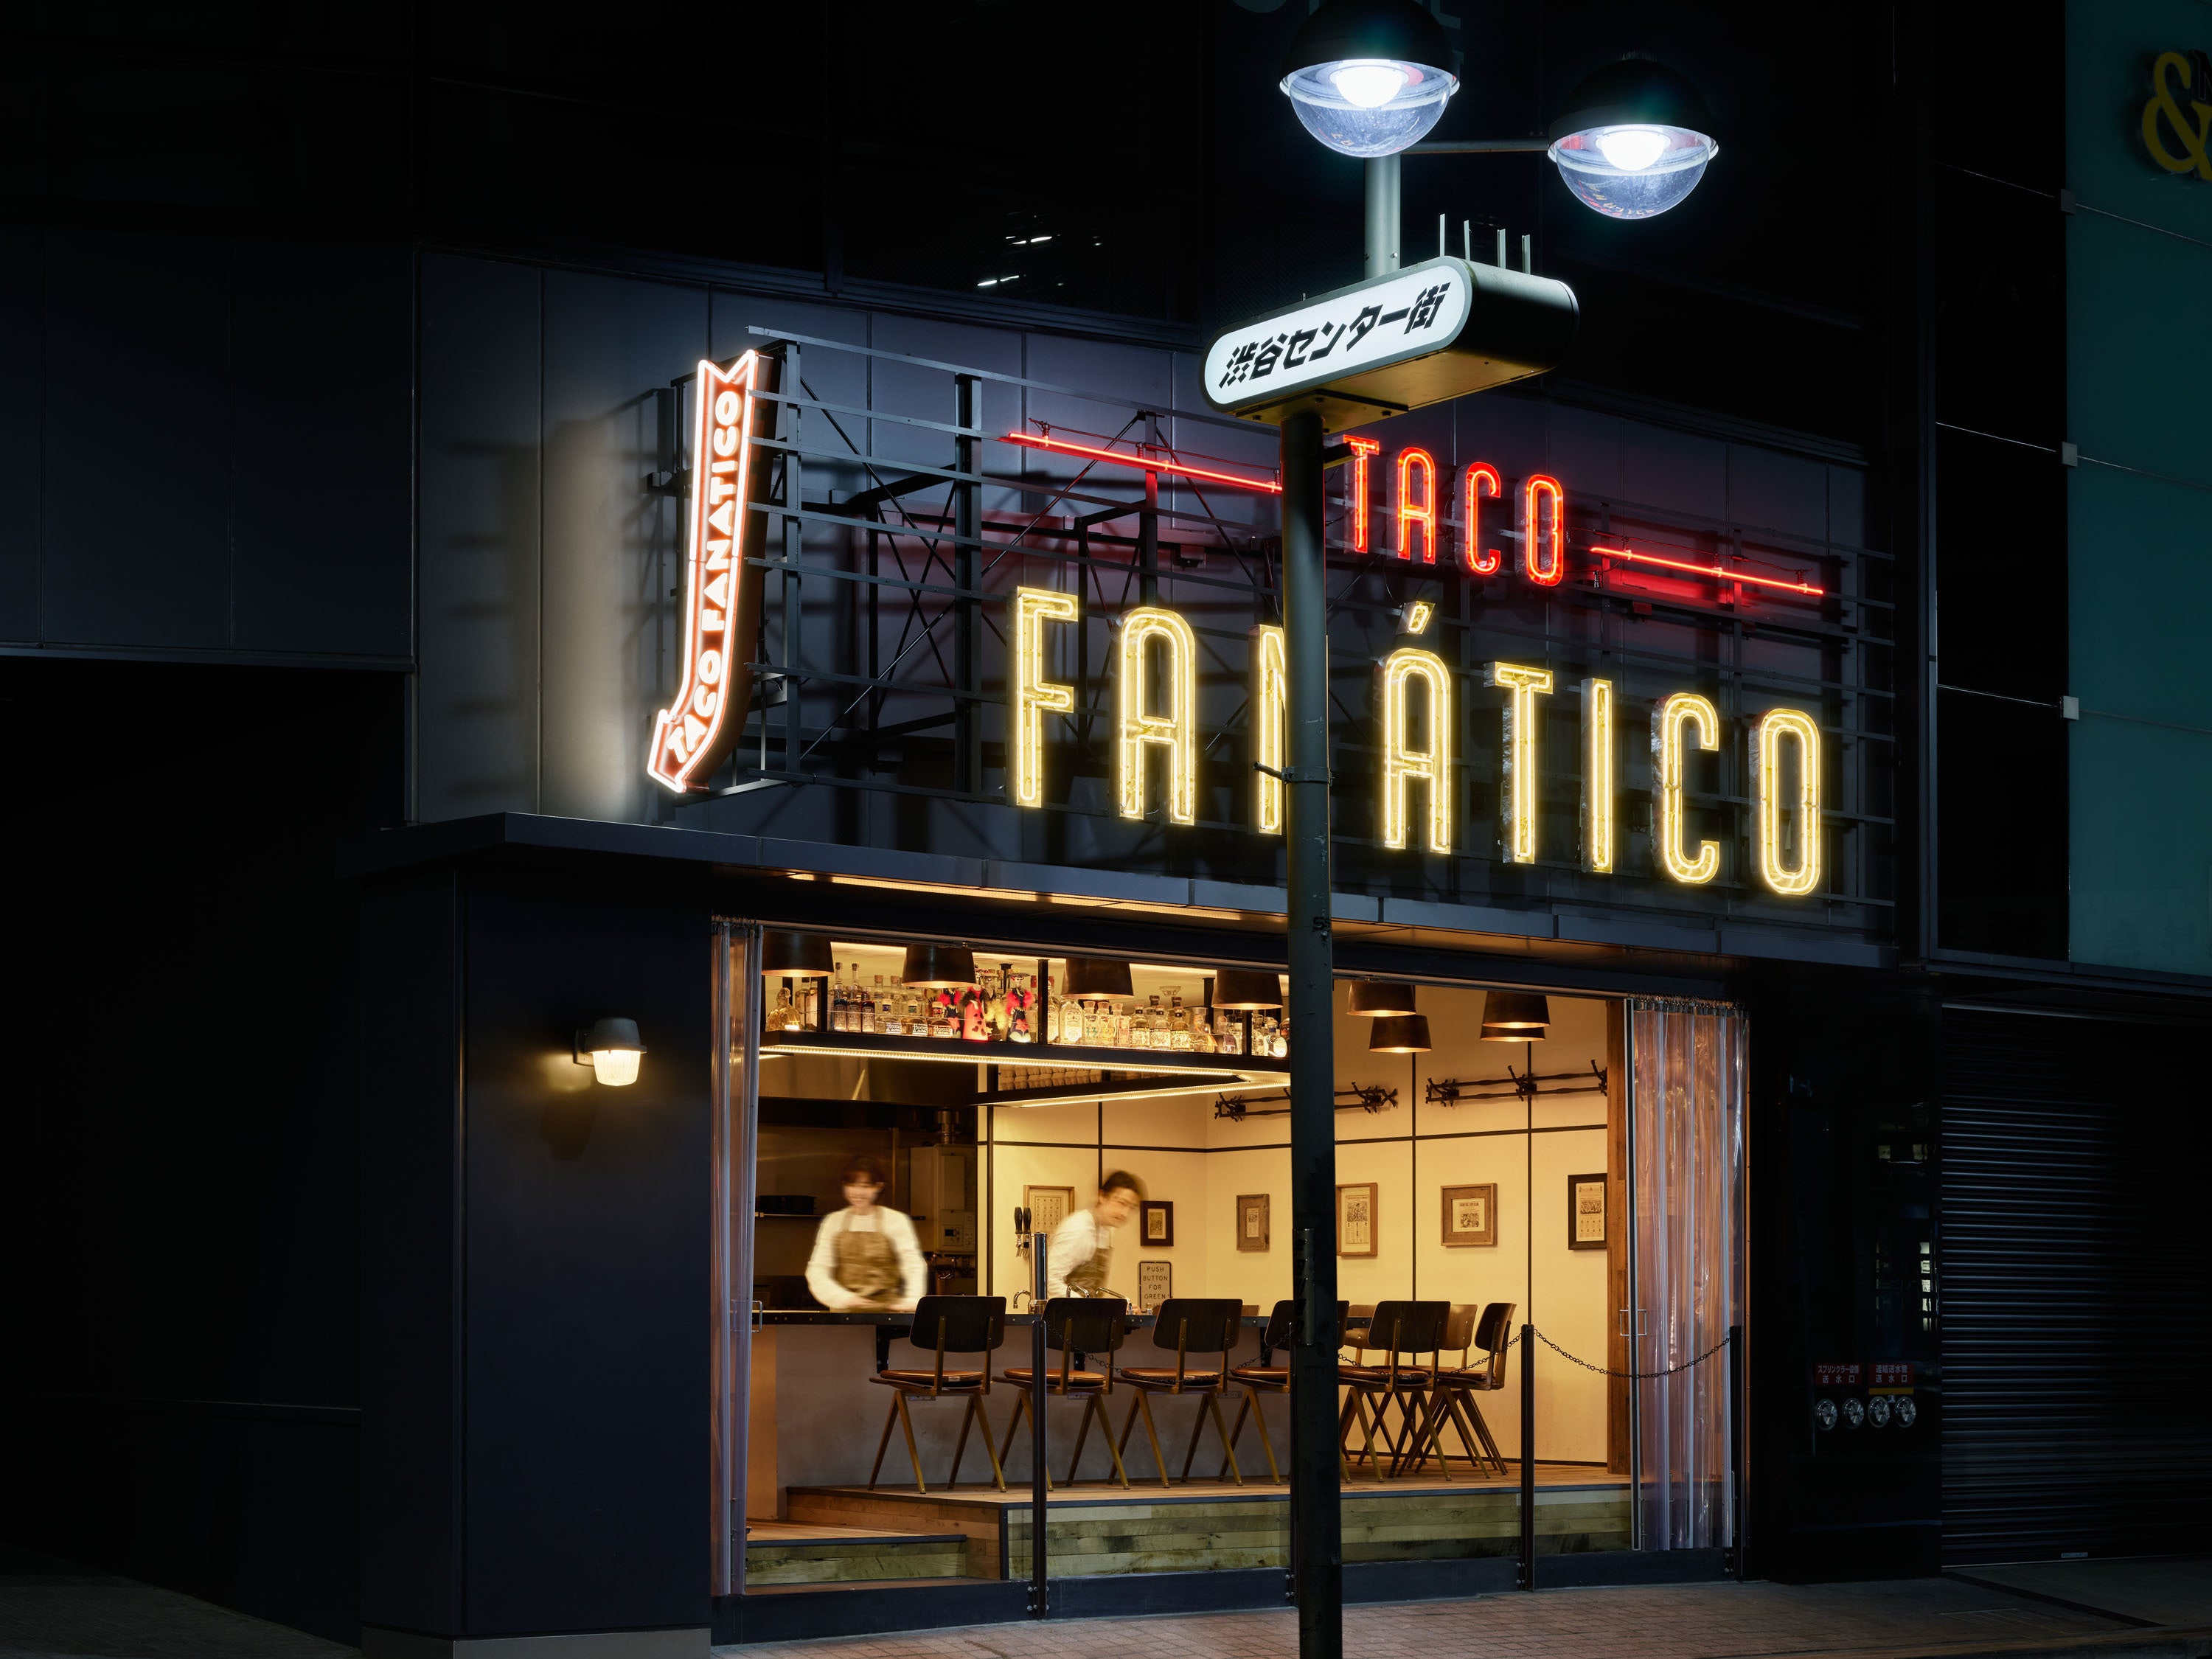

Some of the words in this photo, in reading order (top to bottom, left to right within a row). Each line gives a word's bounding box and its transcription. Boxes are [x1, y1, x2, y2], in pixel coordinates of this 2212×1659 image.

[1218, 282, 1452, 389] 渋谷センター街
[1343, 435, 1565, 585] TACO
[667, 649, 722, 765] TACO
[702, 390, 740, 633] FANATICO
[1822, 1374, 1856, 1383] 送水口
[1876, 1364, 1908, 1374] 連結送水管
[1876, 1374, 1908, 1383] 送水口
